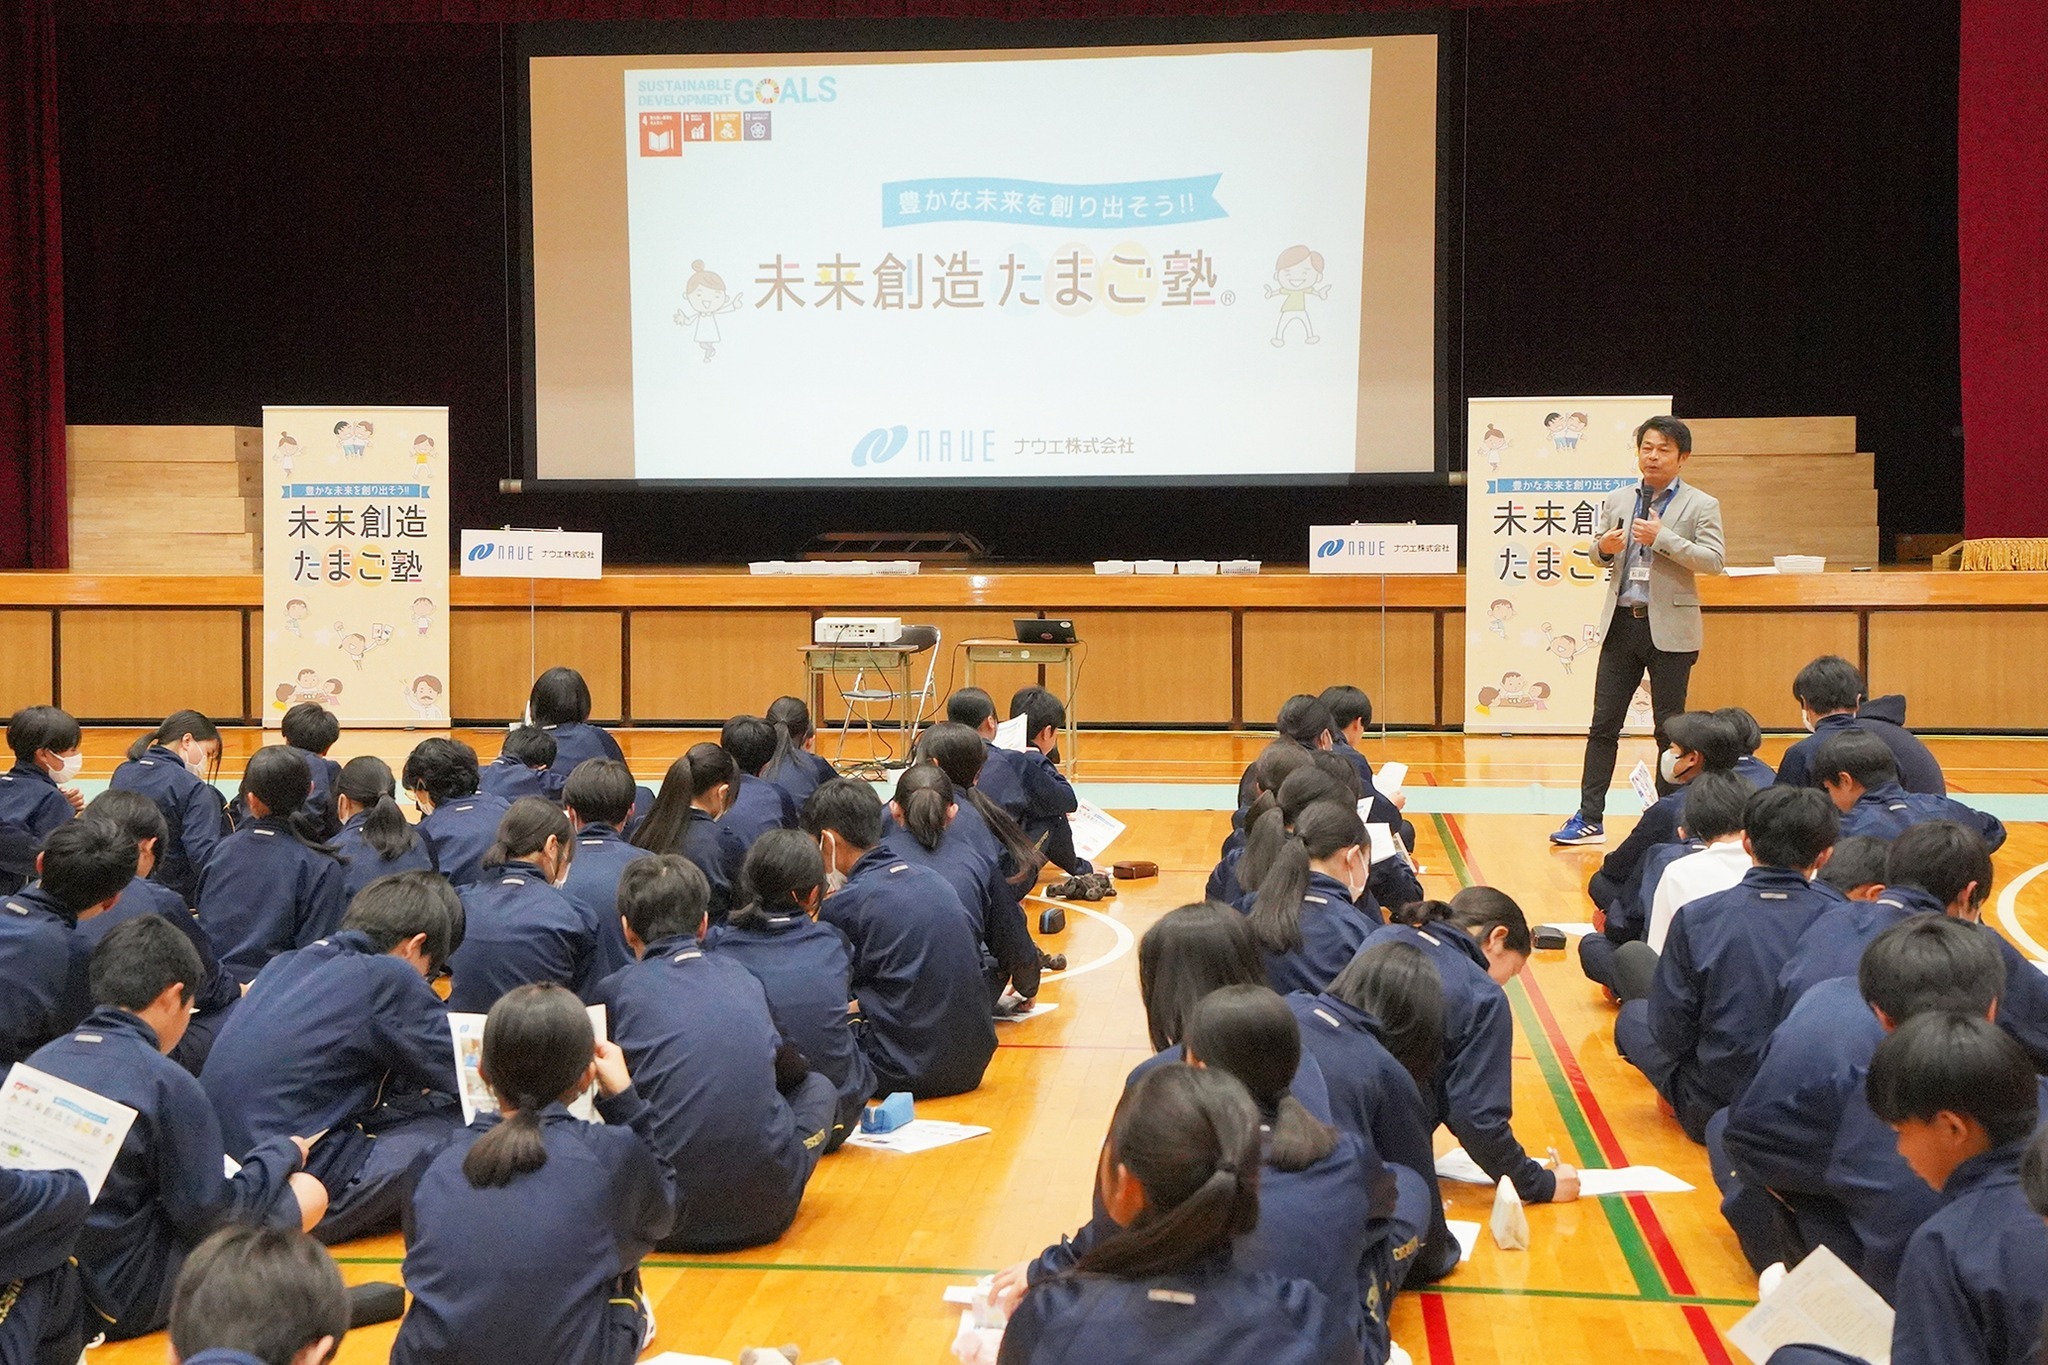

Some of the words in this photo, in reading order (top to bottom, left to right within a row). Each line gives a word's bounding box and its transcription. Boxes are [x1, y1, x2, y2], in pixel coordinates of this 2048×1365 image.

[638, 79, 732, 92] SUSTAINABLE
[734, 76, 837, 105] GOALS
[638, 94, 732, 106] DEVELOPMENT
[918, 430, 995, 462] NAUE
[1014, 436, 1135, 455] ナウエ株式会社
[288, 504, 428, 539] 未来創造
[498, 545, 533, 561] NAUE
[541, 550, 595, 559] ナウエ株式会社
[1348, 541, 1385, 556] NAUE
[1394, 544, 1450, 553] ナウエ株式会社
[294, 549, 423, 582] たまご塾
